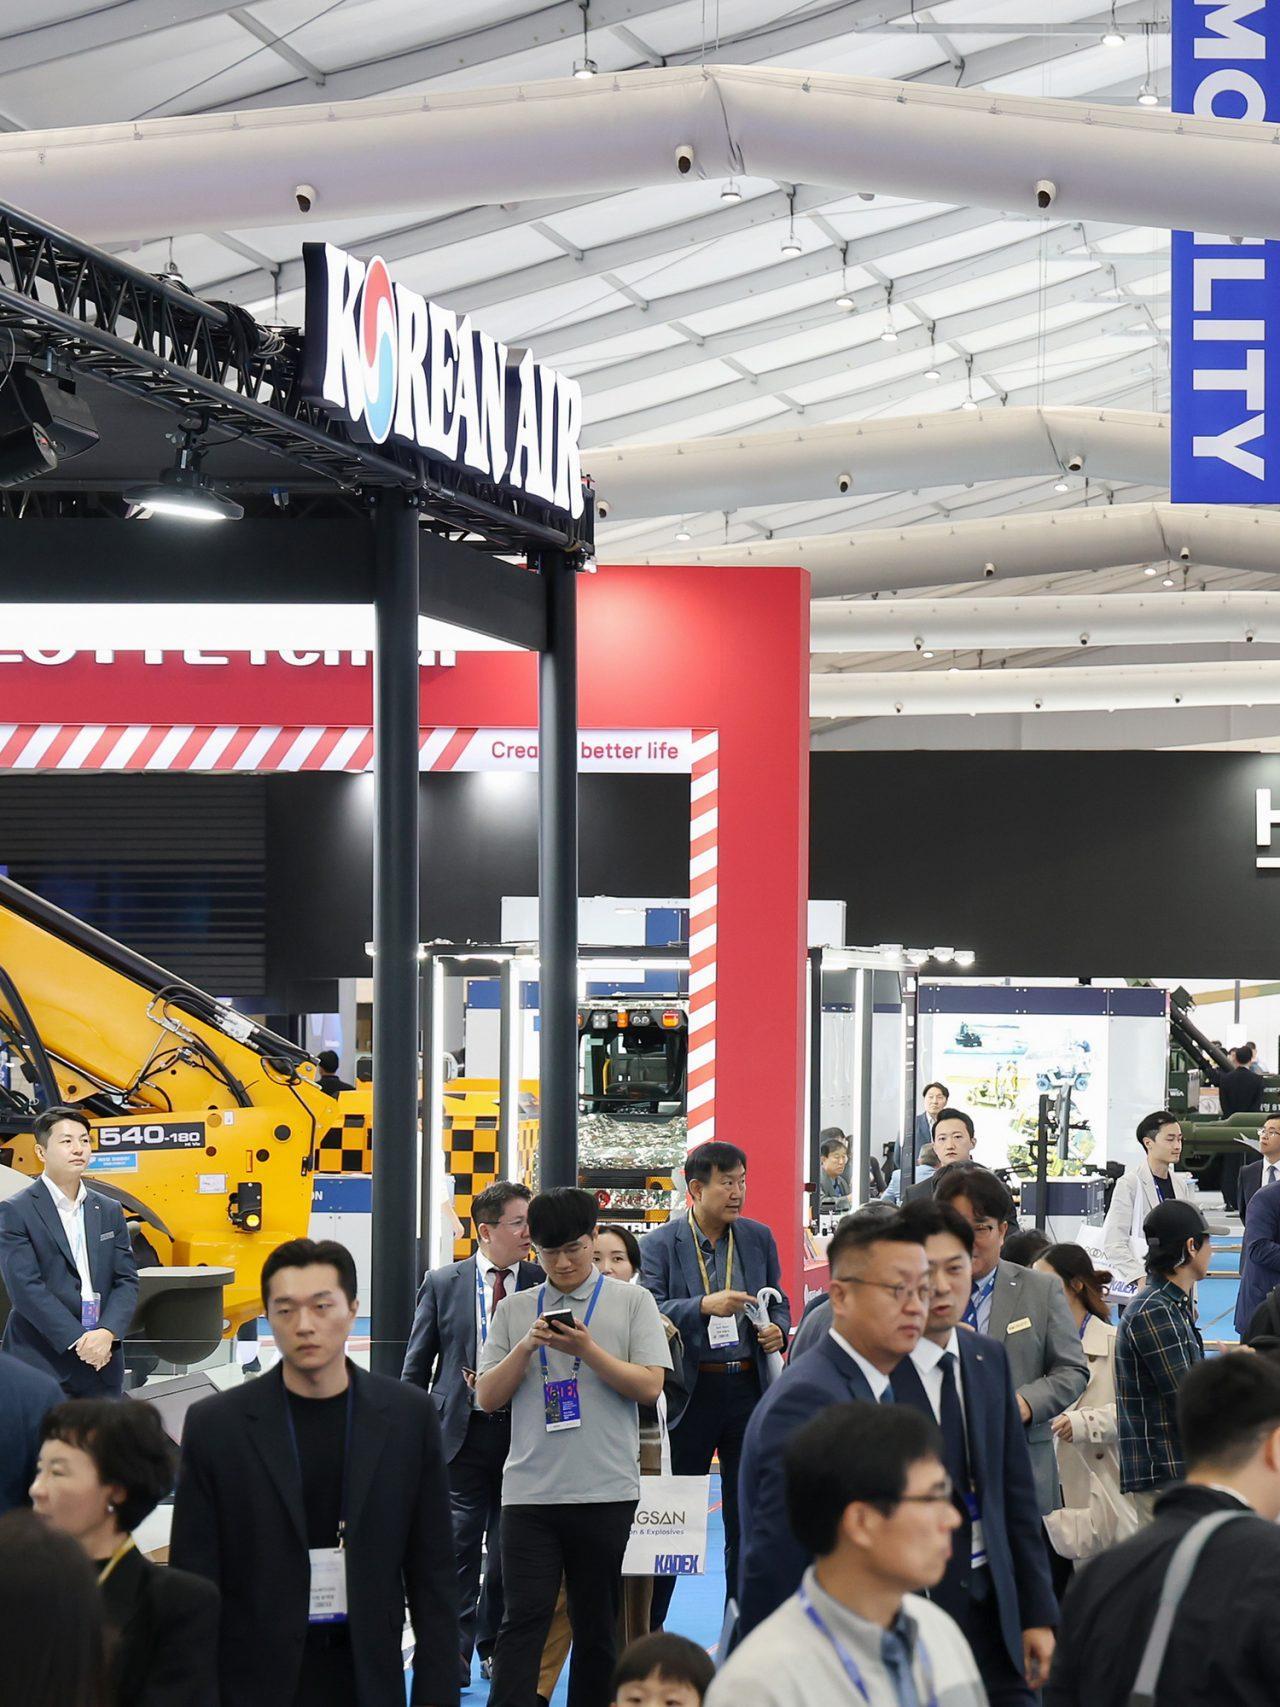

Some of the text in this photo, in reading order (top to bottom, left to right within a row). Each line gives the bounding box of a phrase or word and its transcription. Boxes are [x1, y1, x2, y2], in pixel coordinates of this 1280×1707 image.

[1193, 0, 1266, 481] MOLITY
[323, 242, 584, 520] KOREAN AIR
[491, 741, 679, 760] Crea better life
[100, 1125, 200, 1146] 540-180
[647, 1529, 685, 1537] Explosives
[655, 1554, 699, 1574] KADEX
